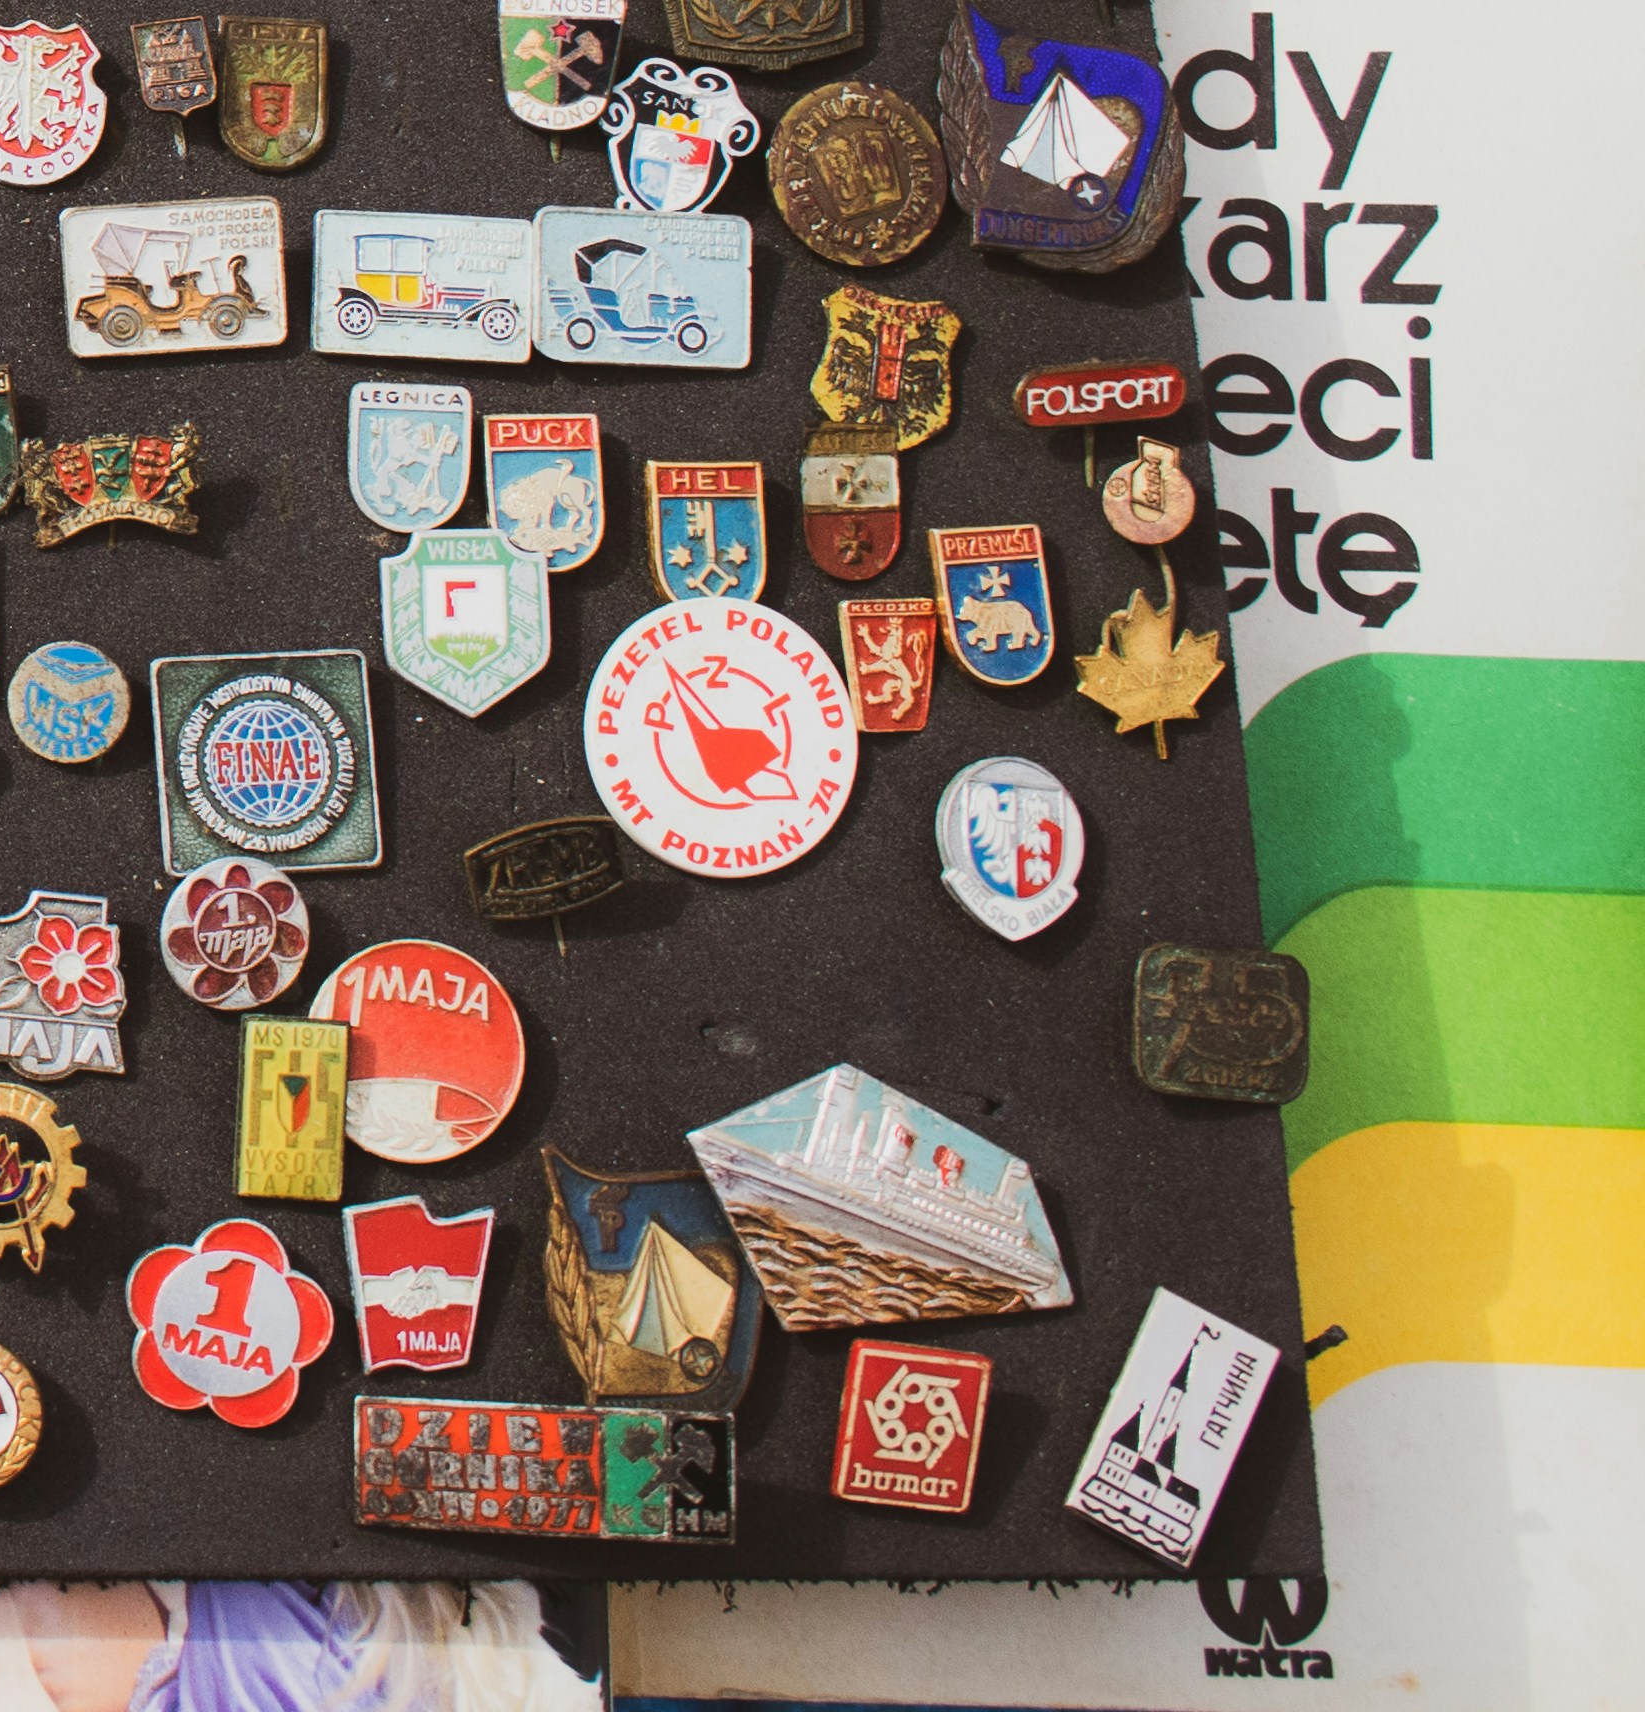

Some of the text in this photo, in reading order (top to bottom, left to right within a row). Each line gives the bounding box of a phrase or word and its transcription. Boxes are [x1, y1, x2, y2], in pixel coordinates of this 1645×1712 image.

[512, 99, 600, 127] KLADNO
[358, 389, 465, 407] LEGNICA
[1026, 375, 1175, 417] POLSPORT
[497, 420, 588, 447] PUCK
[670, 469, 742, 492] HEL
[426, 540, 498, 560] WISŁA
[943, 531, 1037, 558] PRZEMYŚL
[851, 600, 934, 613] KŁODZKO
[597, 609, 845, 735] PEZETEL POLAND
[27, 689, 108, 735] WSK
[215, 742, 322, 786] FINAŁ
[199, 930, 272, 969] maja
[253, 1024, 341, 1047] MS 1970
[162, 1321, 274, 1378] MAJA
[1199, 1349, 1259, 1453] ГАТЧИНА
[851, 1465, 959, 1500] bumar
[1203, 1646, 1335, 1680] watra
